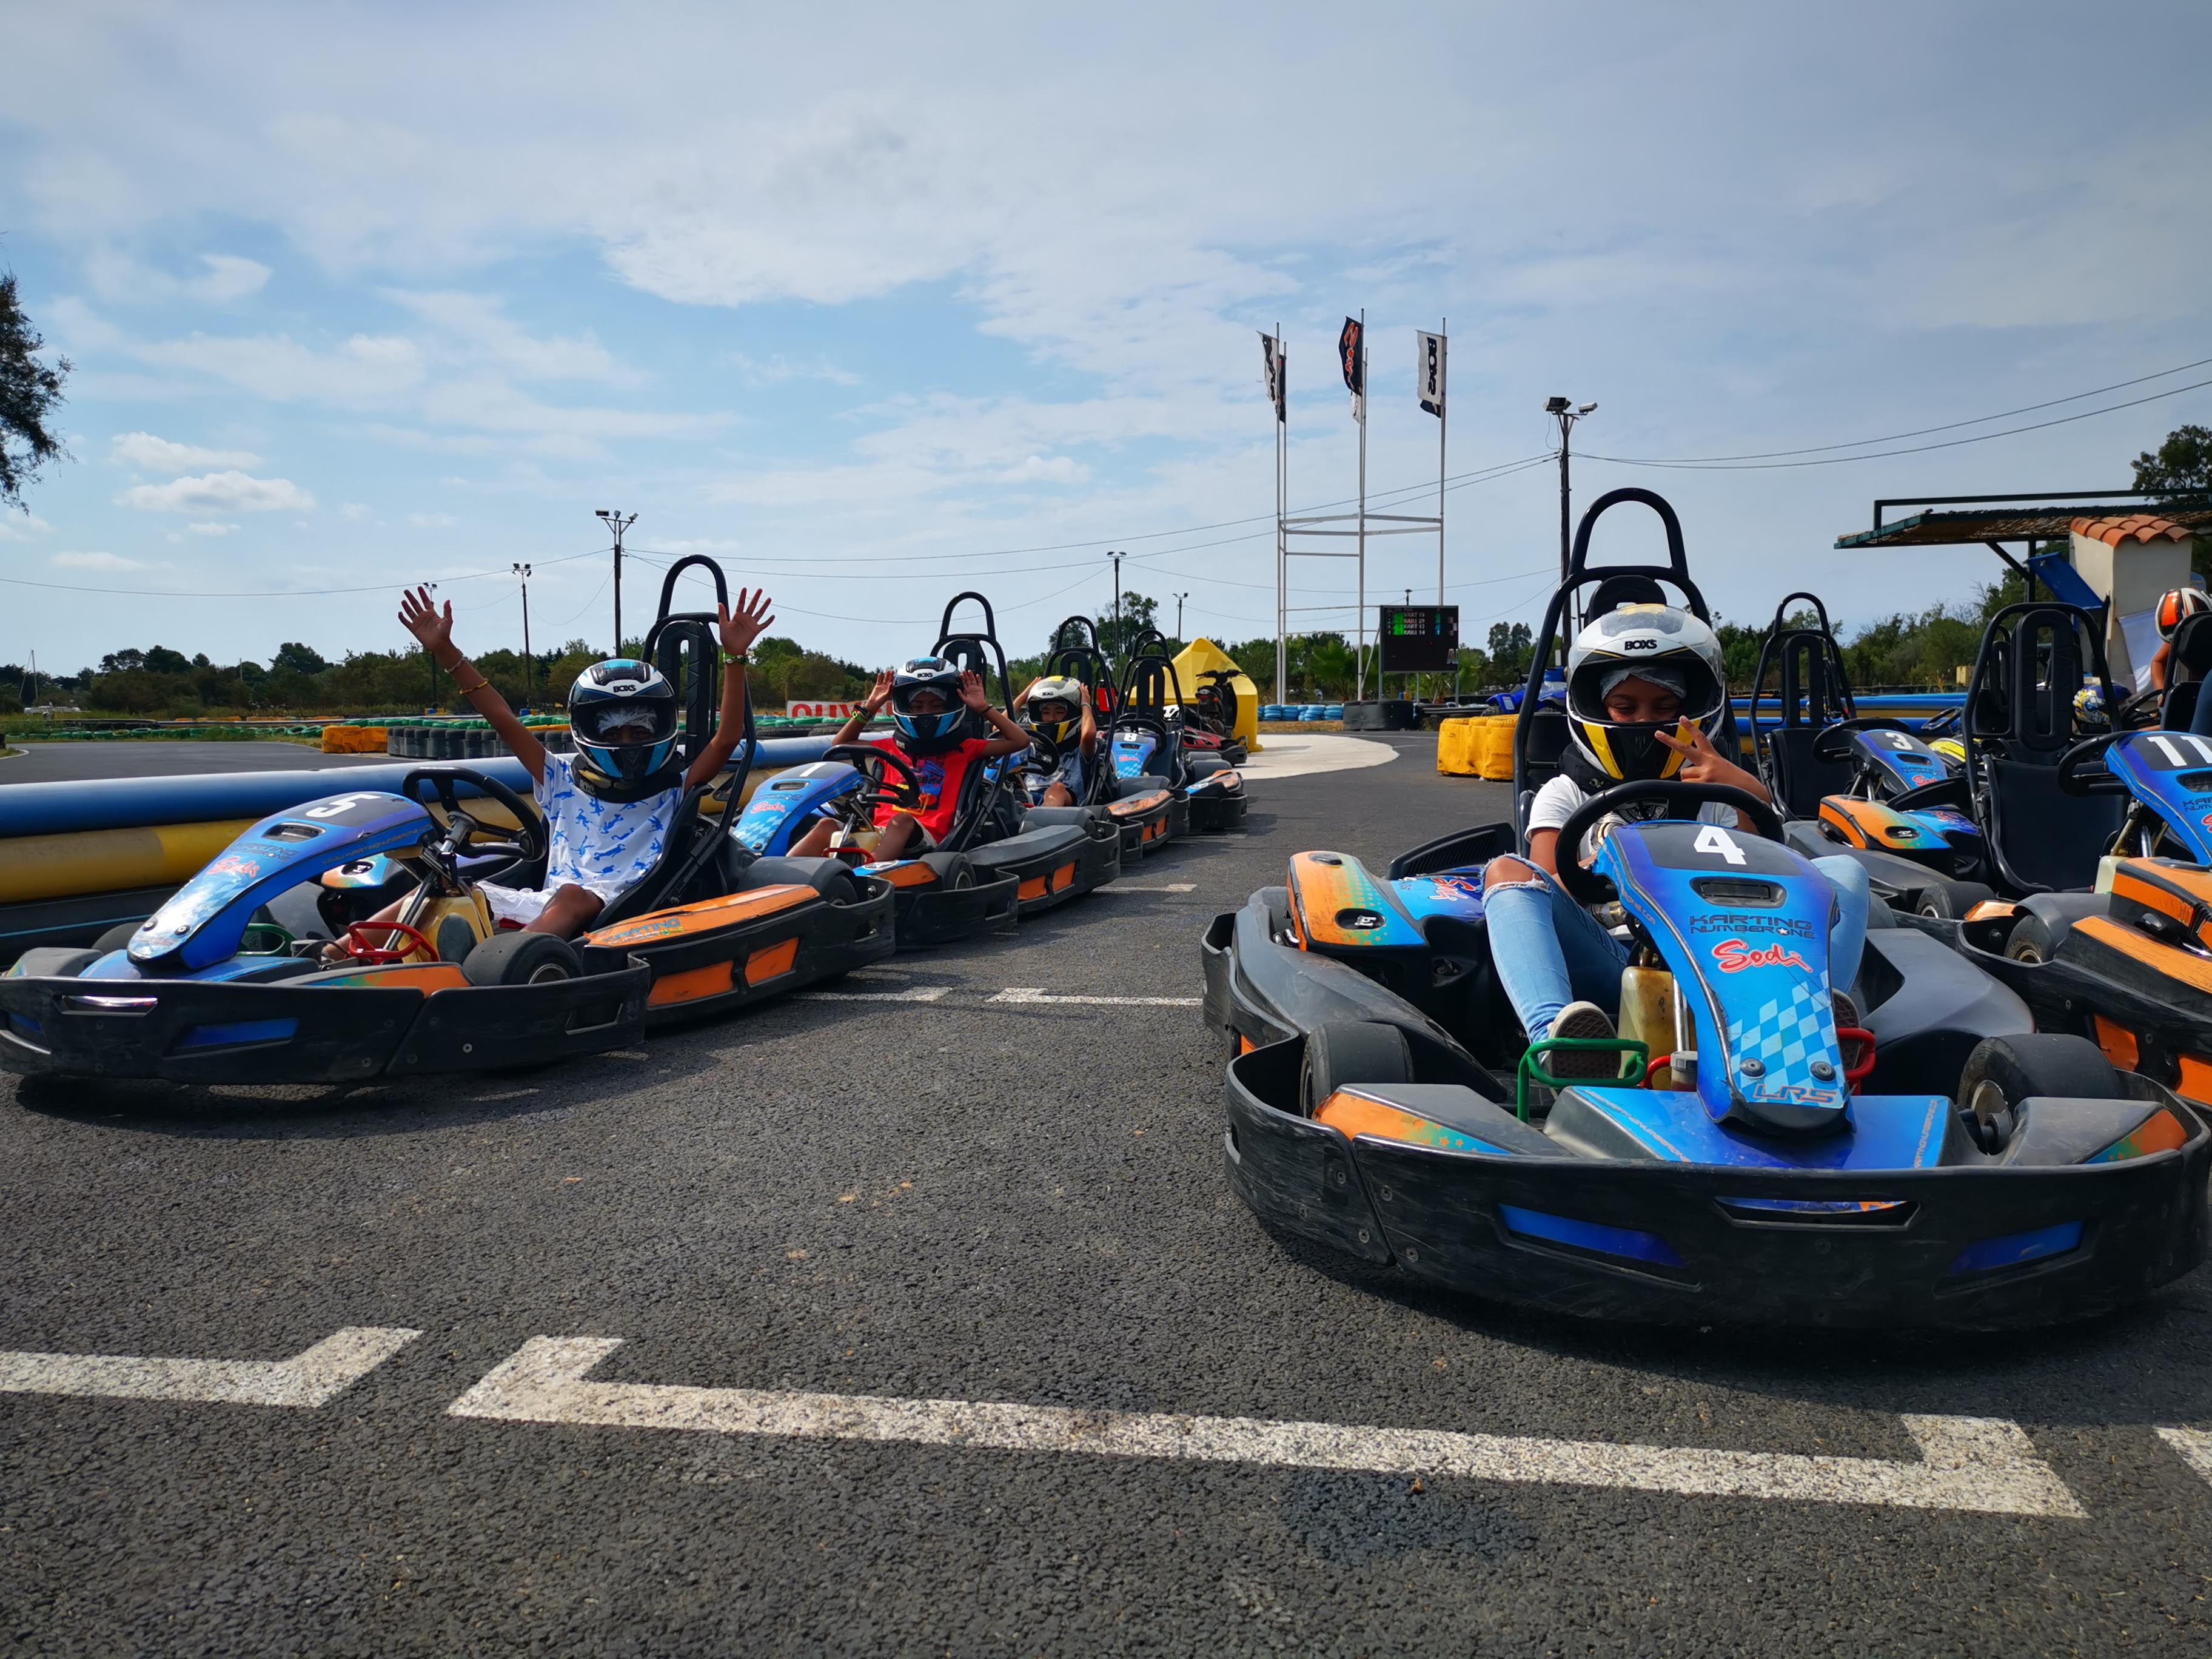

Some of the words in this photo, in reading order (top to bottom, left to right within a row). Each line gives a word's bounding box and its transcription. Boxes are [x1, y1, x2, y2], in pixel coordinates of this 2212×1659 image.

[1124, 732, 1138, 742] 8
[1885, 732, 1913, 750] 3
[2147, 736, 2212, 767] 11
[306, 794, 382, 818] 5
[1693, 825, 1747, 865] 4
[1689, 914, 1812, 930] KARTING
[1711, 938, 1813, 973] Sodi
